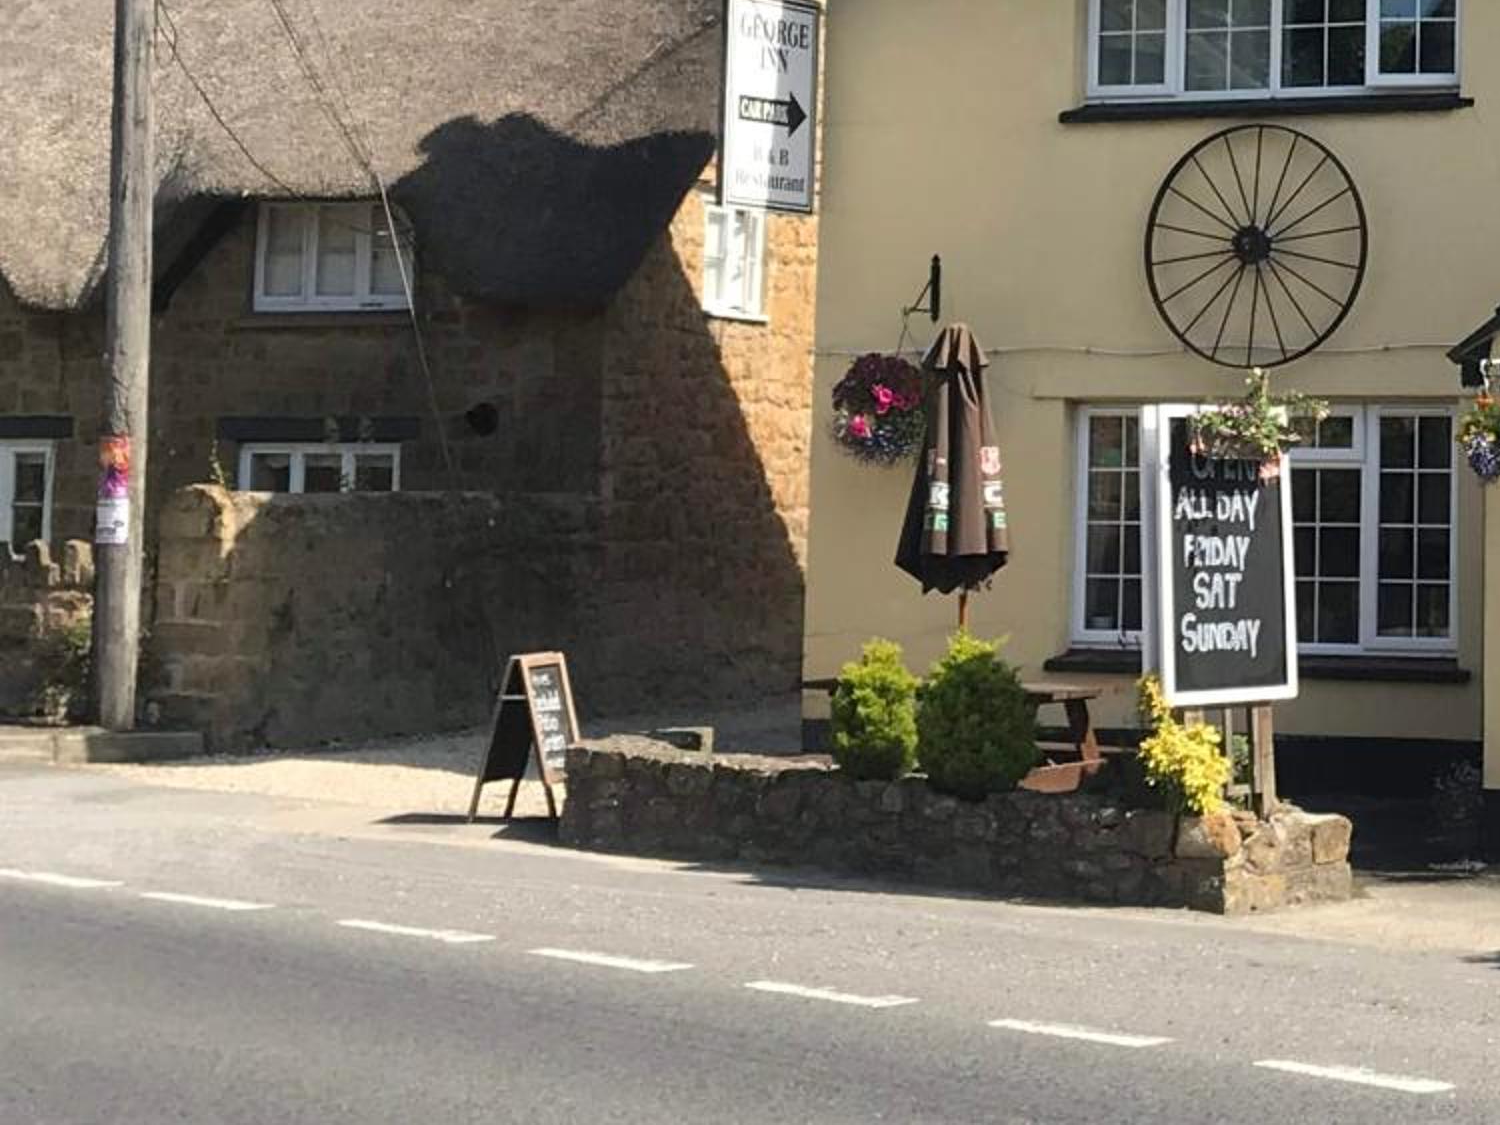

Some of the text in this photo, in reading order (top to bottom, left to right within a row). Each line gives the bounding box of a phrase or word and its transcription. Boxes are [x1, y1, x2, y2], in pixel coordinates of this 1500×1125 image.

[741, 12, 809, 50] GEORGE
[761, 45, 789, 73] INN
[1173, 486, 1260, 532] ALL DAY
[1183, 534, 1251, 572] FRIDAY
[1193, 571, 1243, 610] SAT
